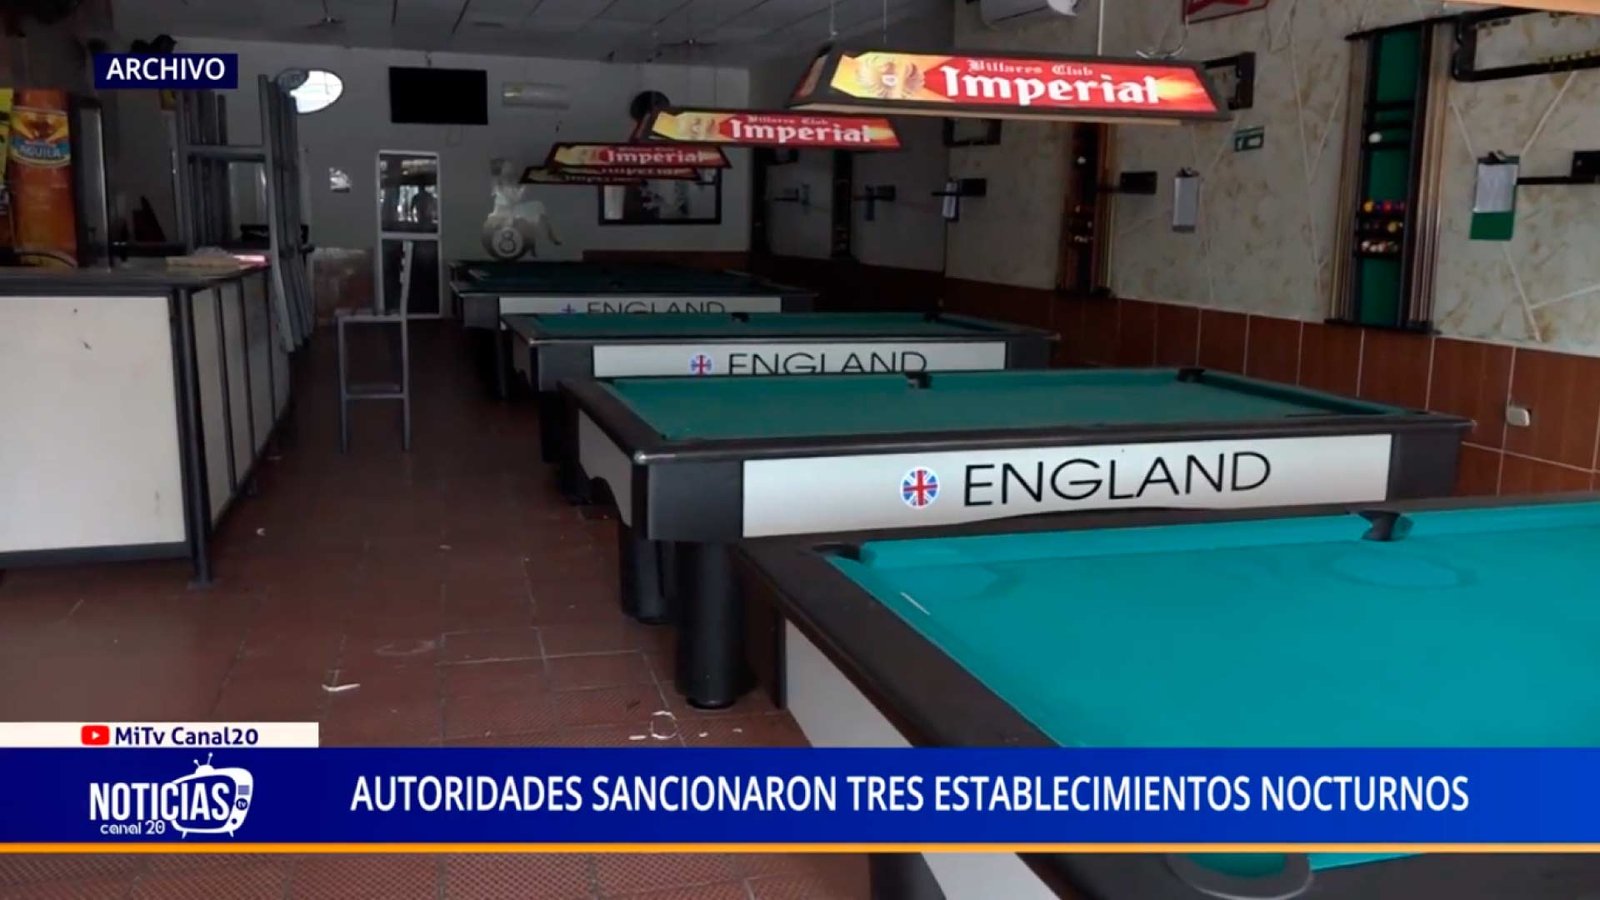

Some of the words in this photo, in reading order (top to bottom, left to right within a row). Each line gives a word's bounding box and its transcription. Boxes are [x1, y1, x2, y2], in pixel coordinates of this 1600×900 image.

[1052, 64, 1094, 77] Club
[940, 66, 1161, 106] Imperial
[729, 119, 872, 143] Imperial
[607, 149, 704, 164] Imperial
[728, 351, 928, 374] ENGLAND
[963, 451, 1271, 507] ENGLAND
